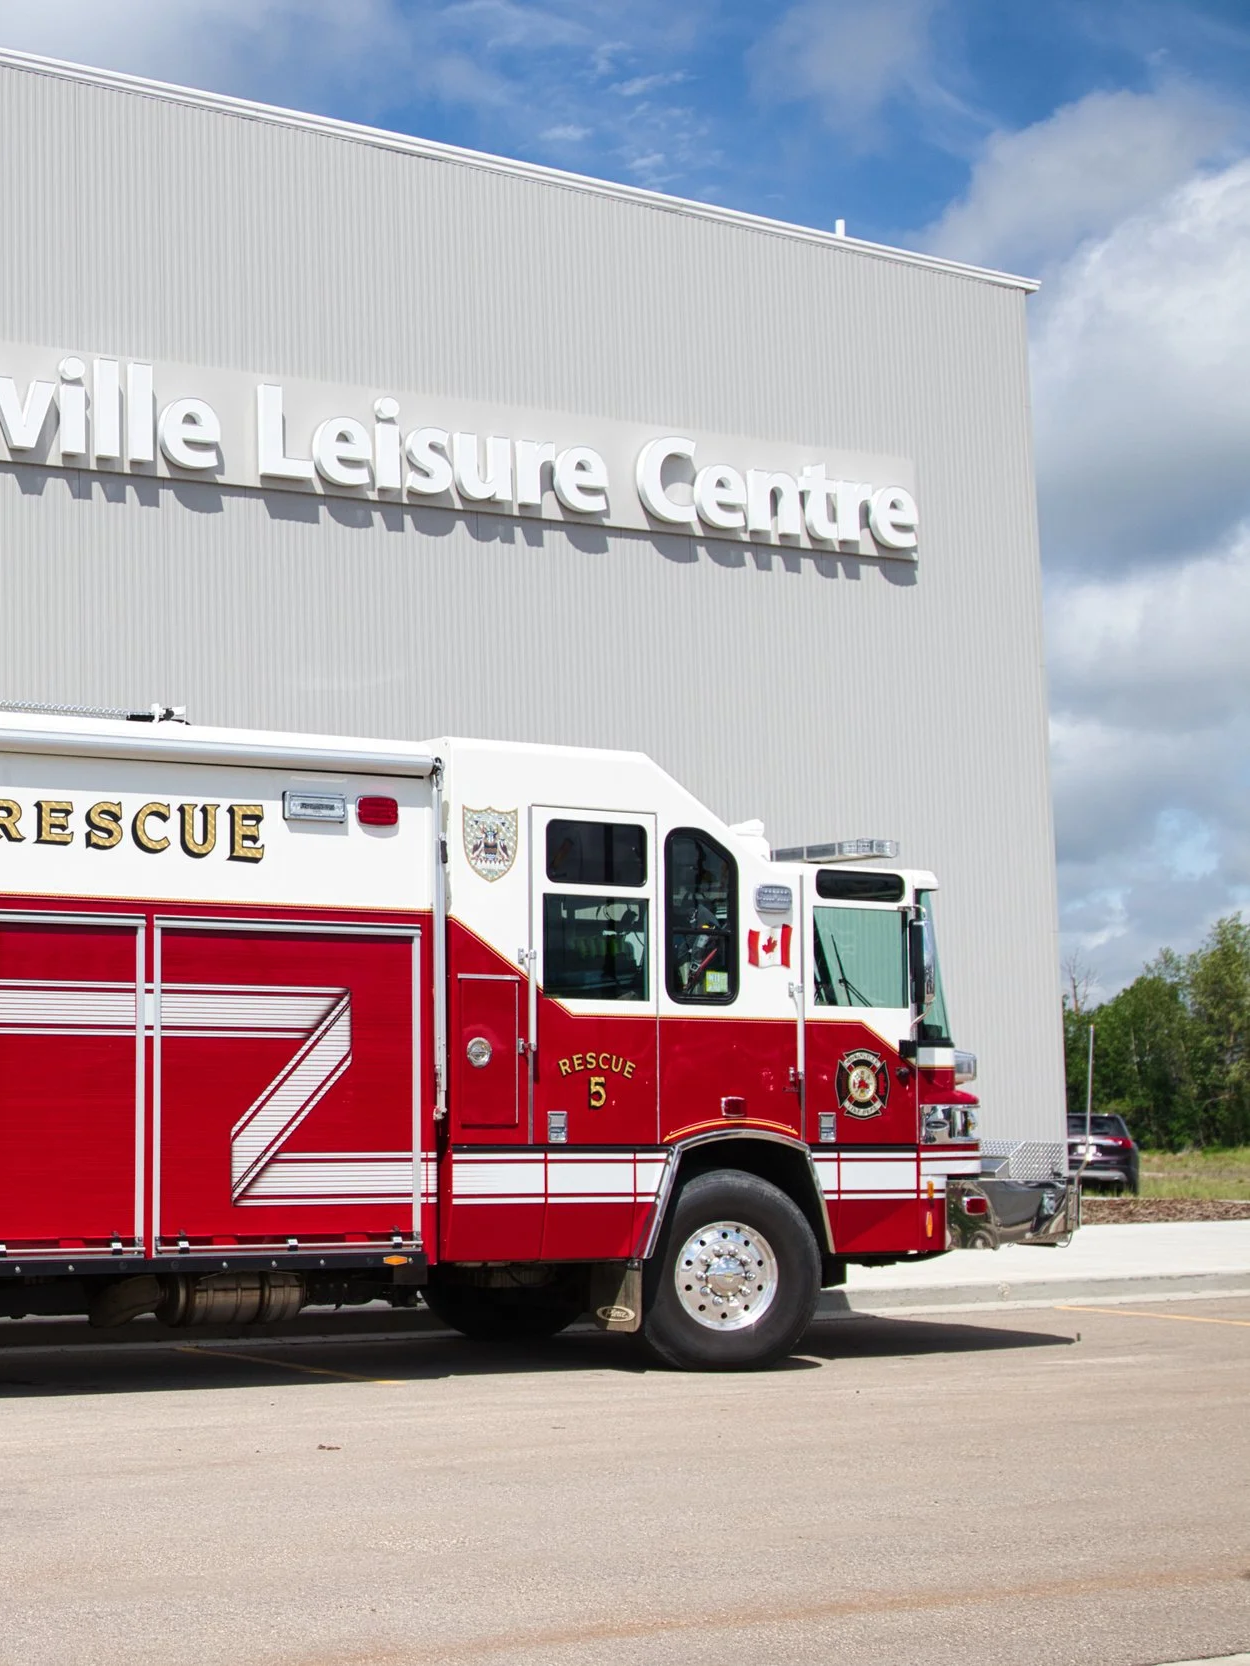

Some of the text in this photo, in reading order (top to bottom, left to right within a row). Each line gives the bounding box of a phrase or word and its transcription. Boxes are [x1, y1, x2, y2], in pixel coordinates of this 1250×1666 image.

[256, 383, 609, 513] Leisure
[636, 435, 918, 549] Centre
[557, 1052, 637, 1079] RESCUE
[588, 1076, 607, 1109] 5
